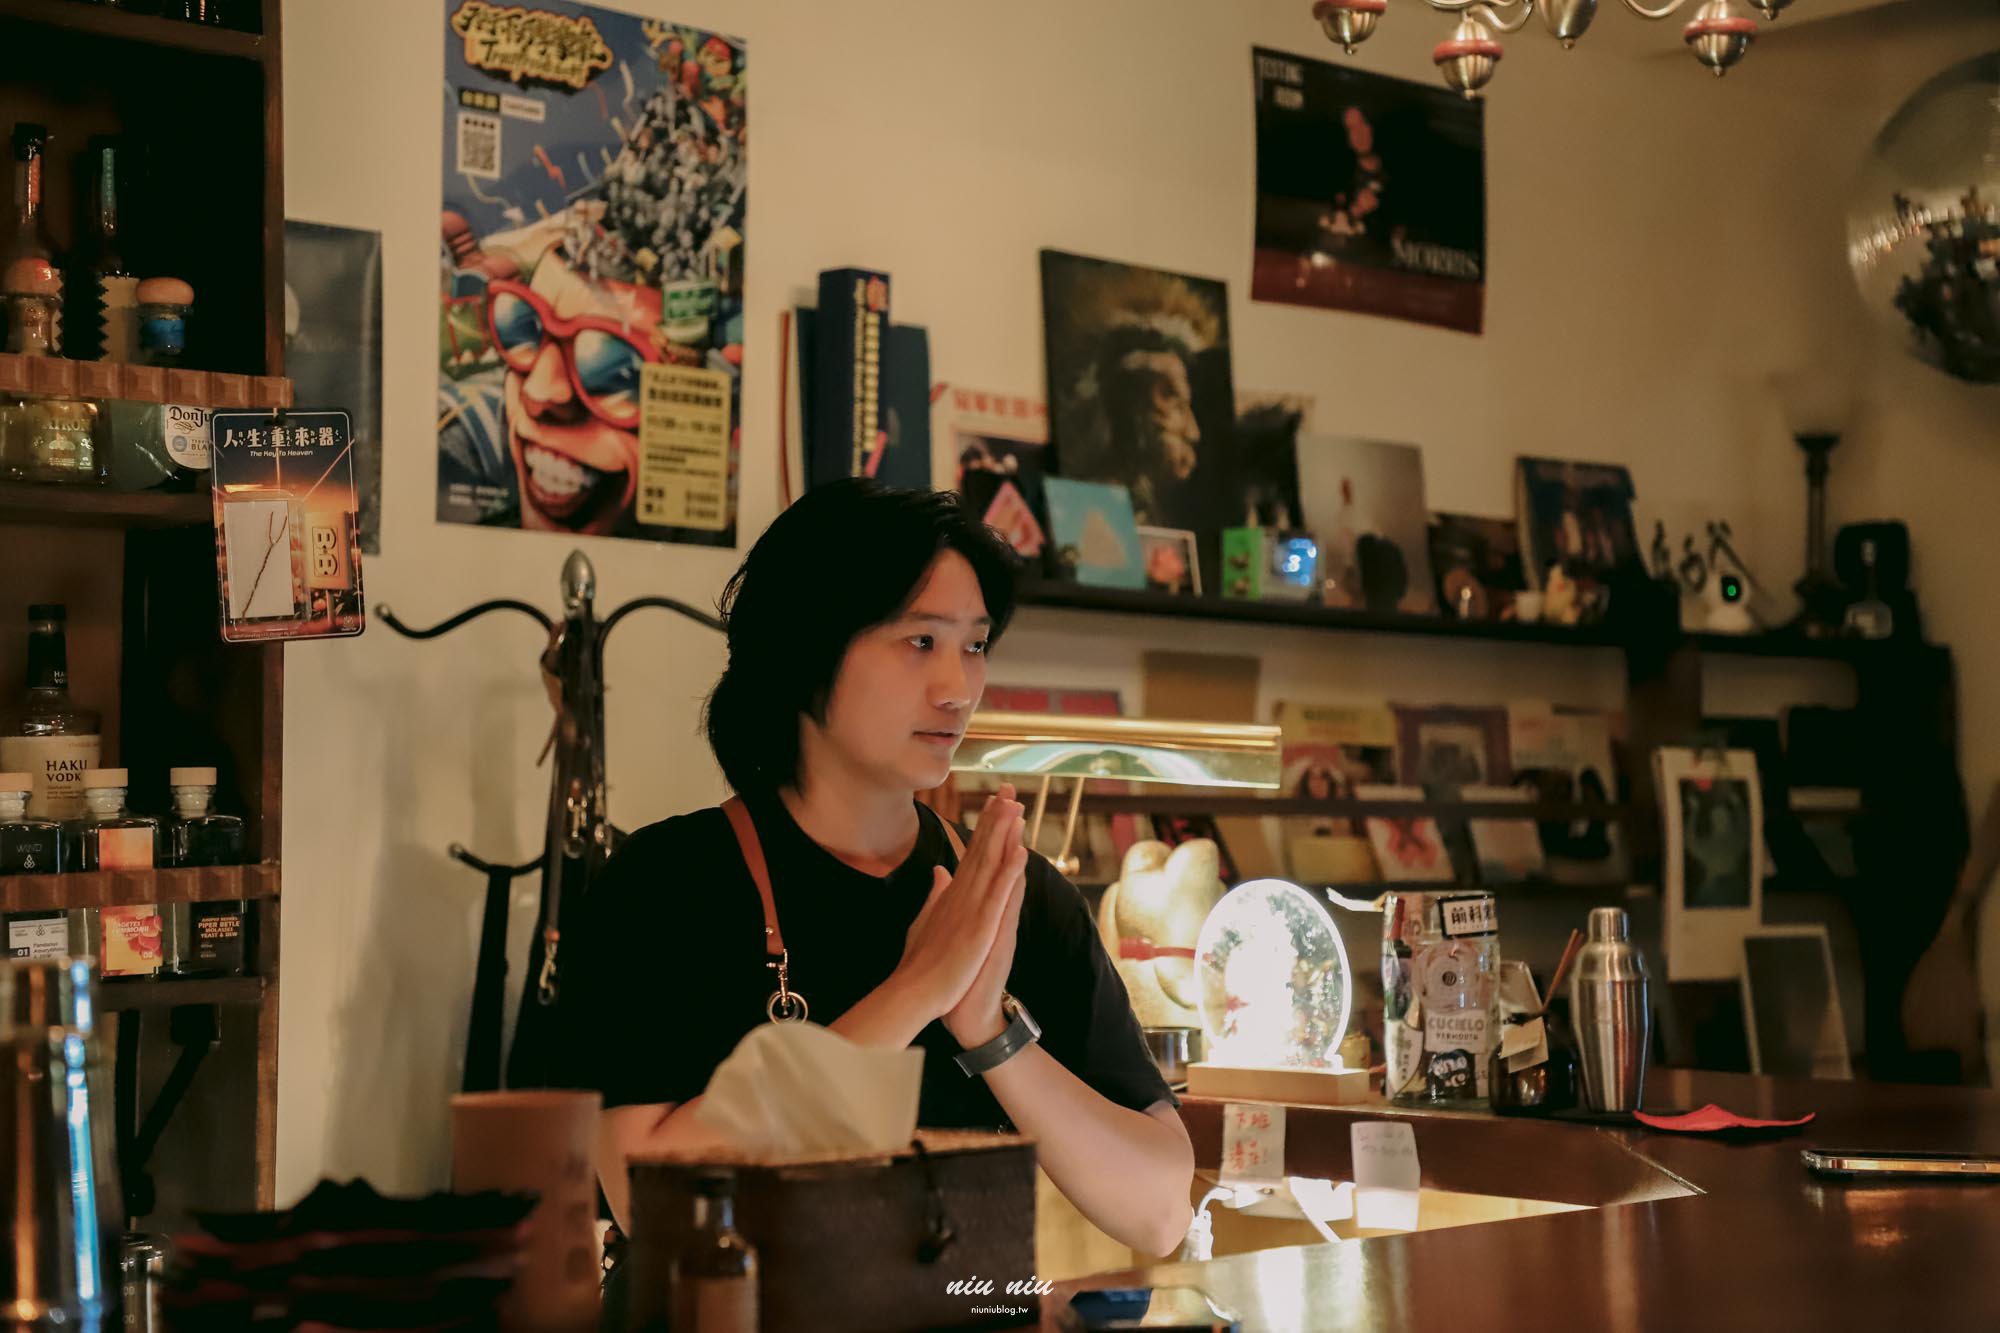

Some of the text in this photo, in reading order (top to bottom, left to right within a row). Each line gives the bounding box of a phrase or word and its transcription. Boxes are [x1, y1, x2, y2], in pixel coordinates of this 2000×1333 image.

[169, 406, 211, 428] DonJu
[263, 450, 276, 458] Key
[287, 449, 314, 457] Heaven
[46, 759, 88, 771] HAKU
[46, 772, 82, 782] VODK
[17, 948, 29, 957] 01
